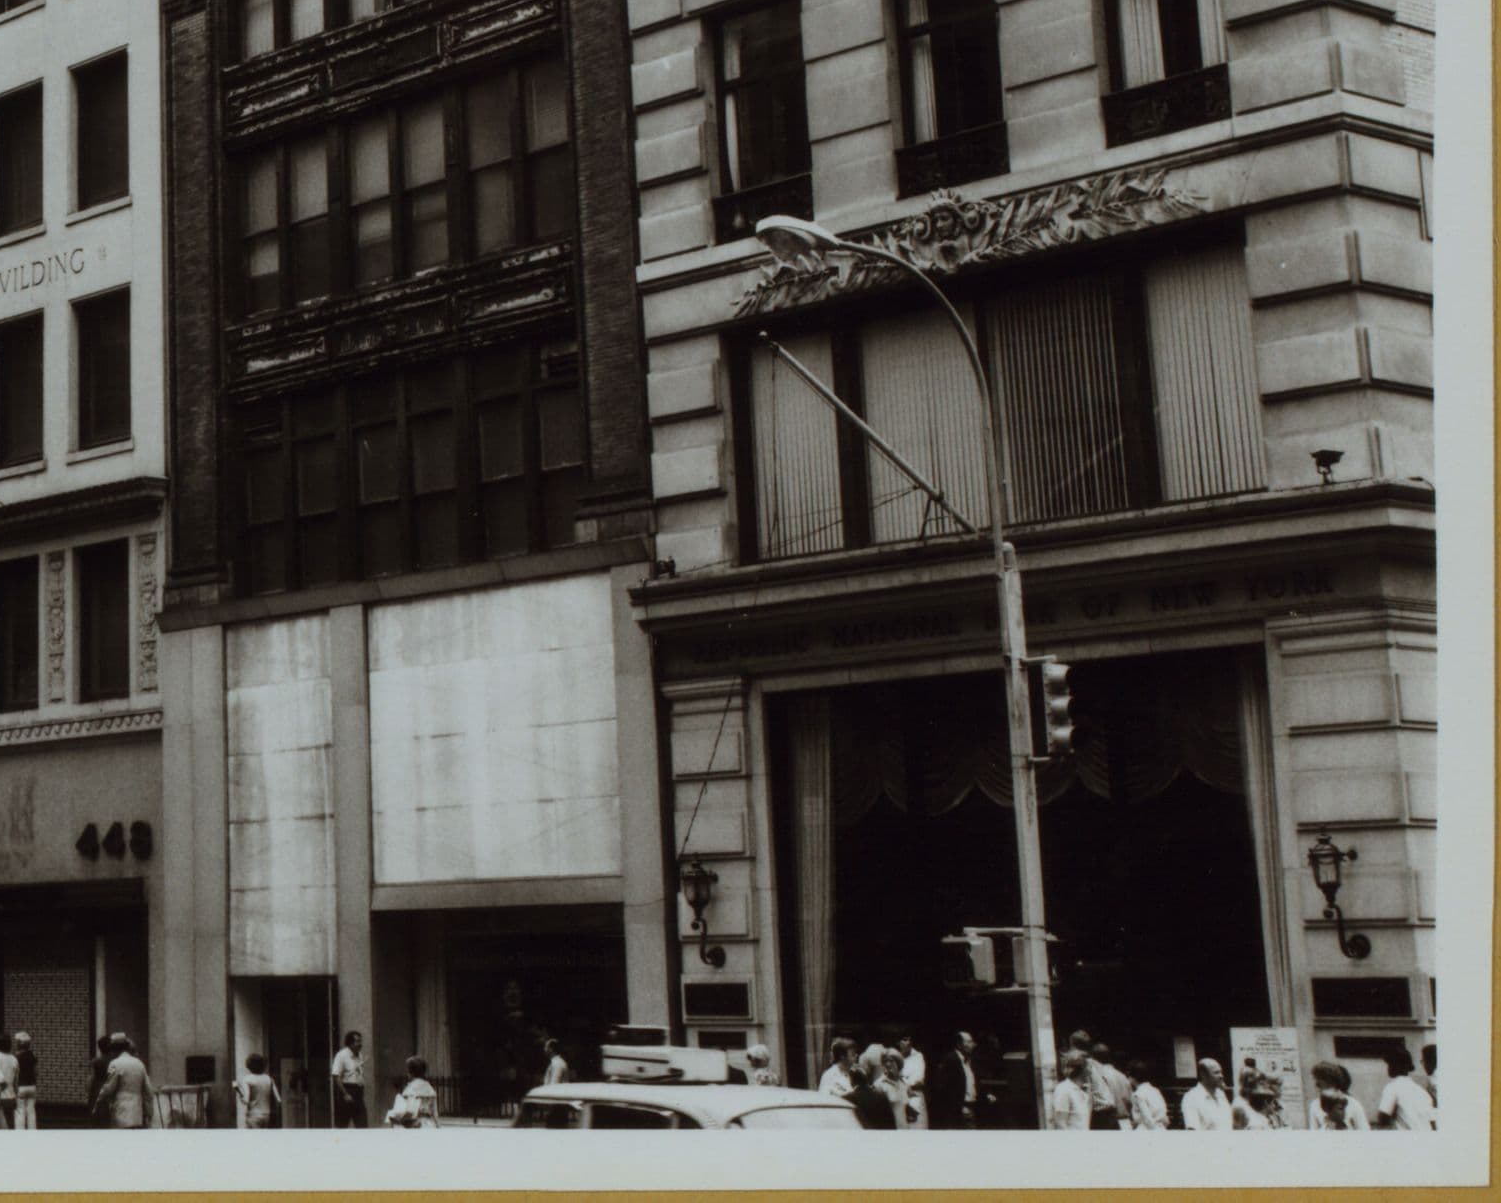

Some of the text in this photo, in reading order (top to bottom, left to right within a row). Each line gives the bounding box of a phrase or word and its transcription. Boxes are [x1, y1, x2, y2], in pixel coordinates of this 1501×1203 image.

[831, 611, 962, 648] NATIONAL
[1080, 592, 1121, 621] OF
[1150, 580, 1220, 612] NEW
[1243, 563, 1335, 601] YORK
